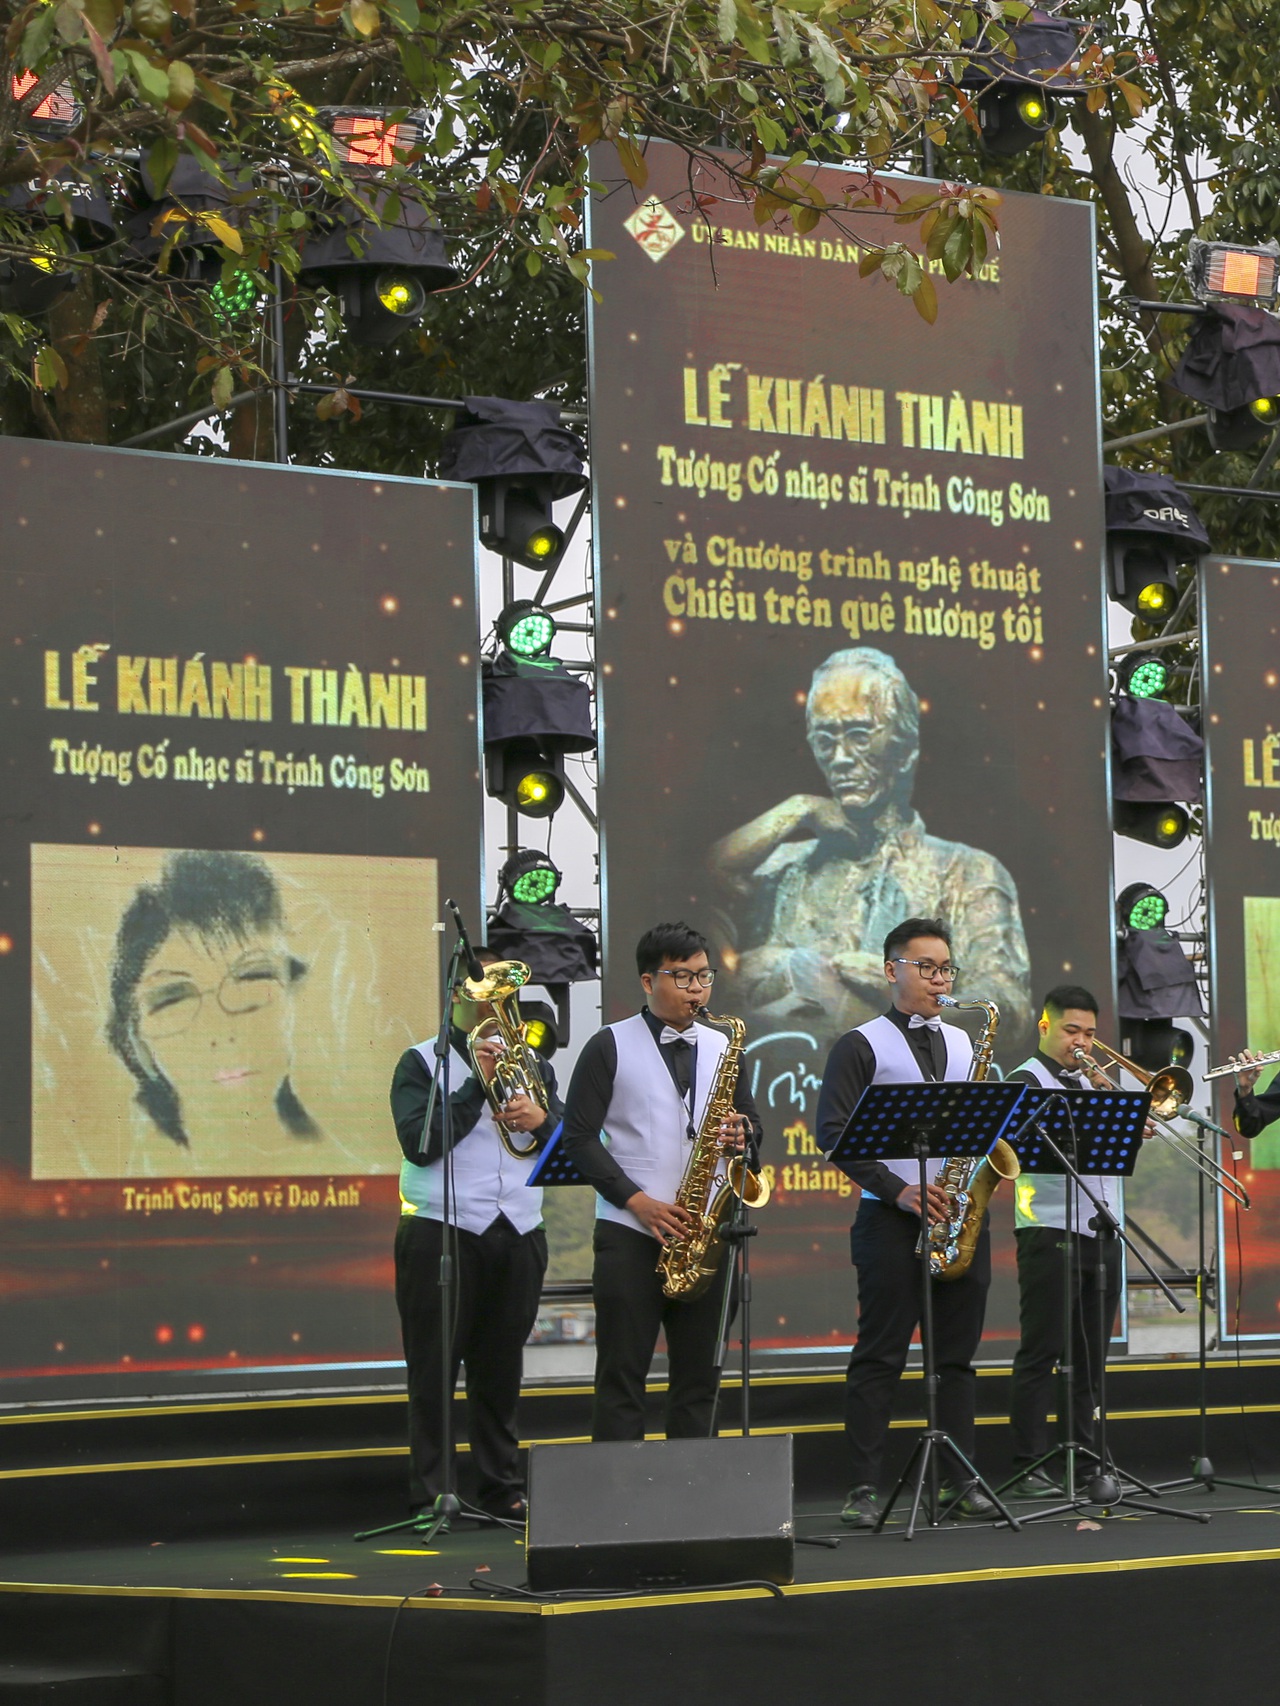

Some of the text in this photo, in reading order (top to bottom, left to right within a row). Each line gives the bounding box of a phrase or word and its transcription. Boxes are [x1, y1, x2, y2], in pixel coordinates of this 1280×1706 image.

[721, 227, 760, 251] BAN
[764, 232, 817, 258] NHÂN
[820, 238, 860, 265] DÂN
[683, 362, 1024, 459] LỄ KHÁNH THÀNH
[657, 445, 1051, 526] Tượng Cố nhạc sĩ Trịnh Công Sơn
[665, 532, 1042, 599] và Chương trình nghệ thuật
[663, 568, 1043, 649] Chiều trên quê hương tôi
[43, 644, 428, 732] LỄ KHÁNH THÀNH
[51, 739, 430, 798] Tượng Cố nhạc sĩ Trịnh Công Sơn
[123, 1187, 174, 1216] Trịnh
[177, 1185, 222, 1214] Công
[227, 1185, 258, 1209] Sơn
[288, 1184, 319, 1207] Dao
[782, 1161, 853, 1198] tháng
